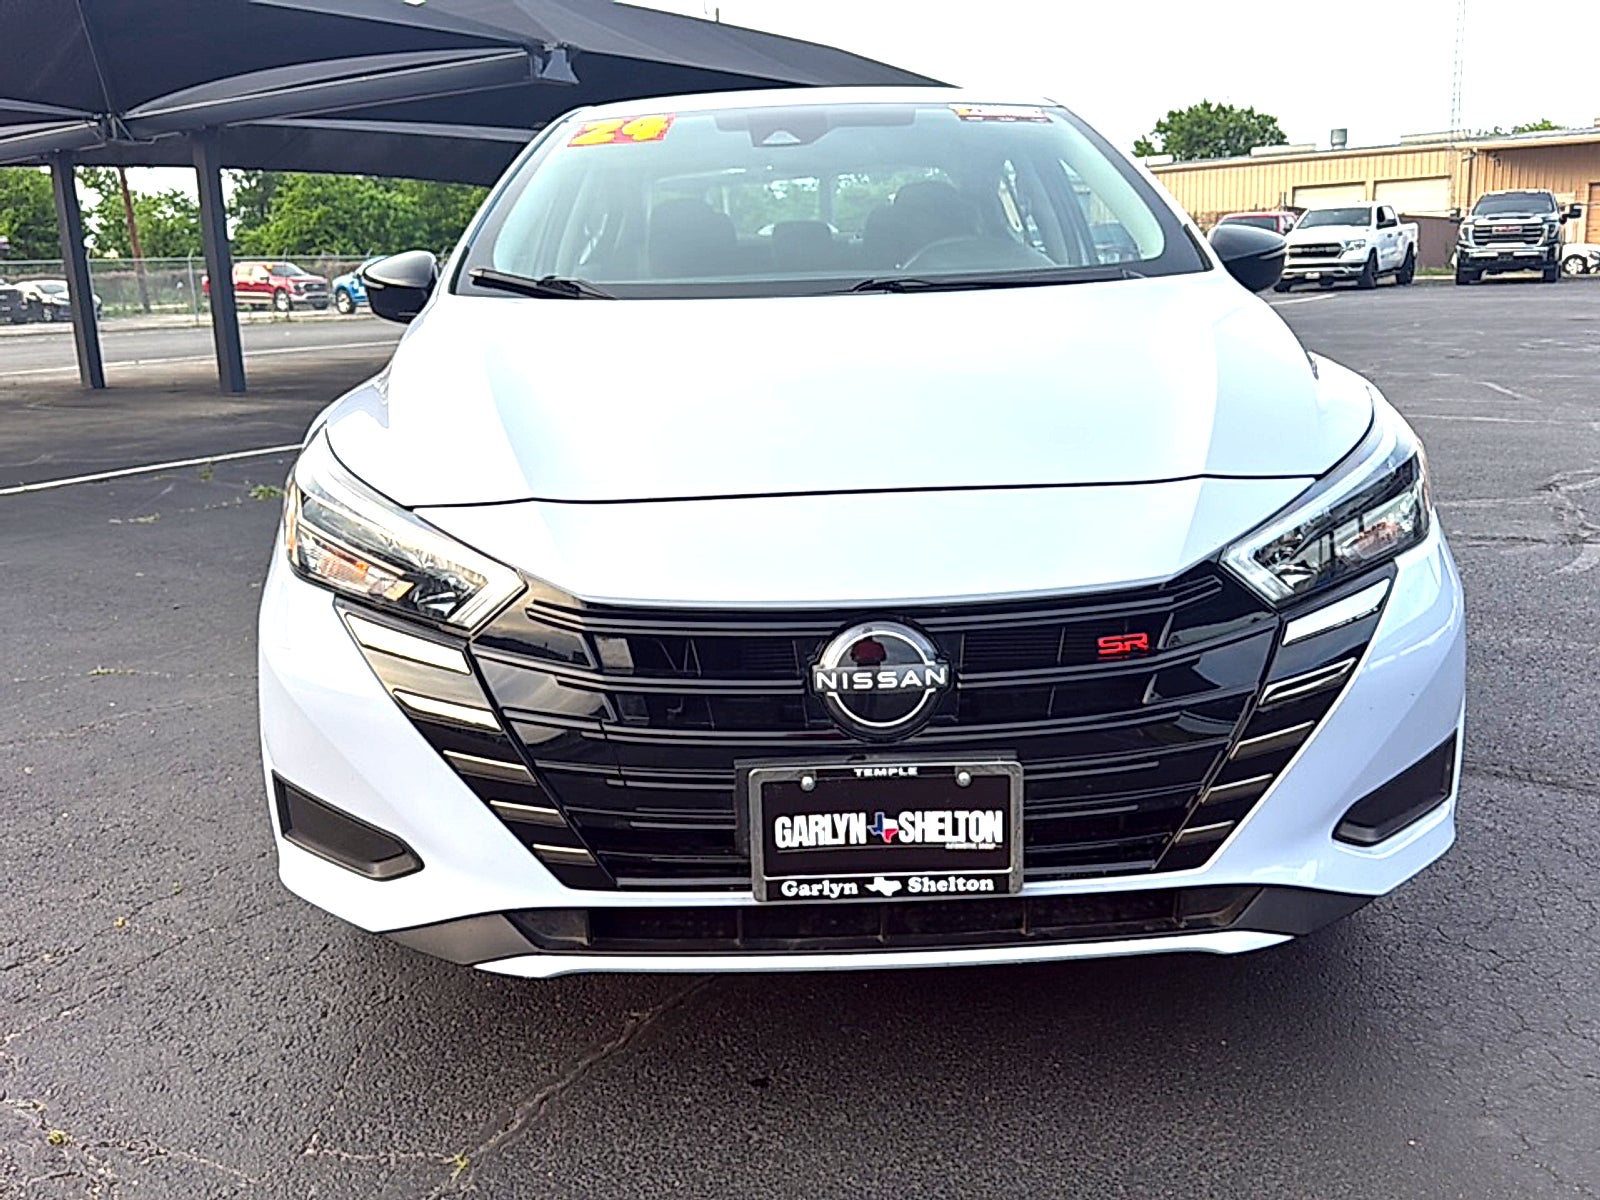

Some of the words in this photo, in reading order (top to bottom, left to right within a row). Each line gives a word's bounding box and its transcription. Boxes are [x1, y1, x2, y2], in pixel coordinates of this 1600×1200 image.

[1098, 633, 1148, 655] SR
[816, 668, 945, 690] NISSAN
[854, 766, 918, 777] TEMPLE
[775, 813, 866, 848] GARLYN
[899, 811, 1003, 843] SHELTON
[781, 880, 859, 898] Garlyn
[907, 878, 994, 893] Shelton
